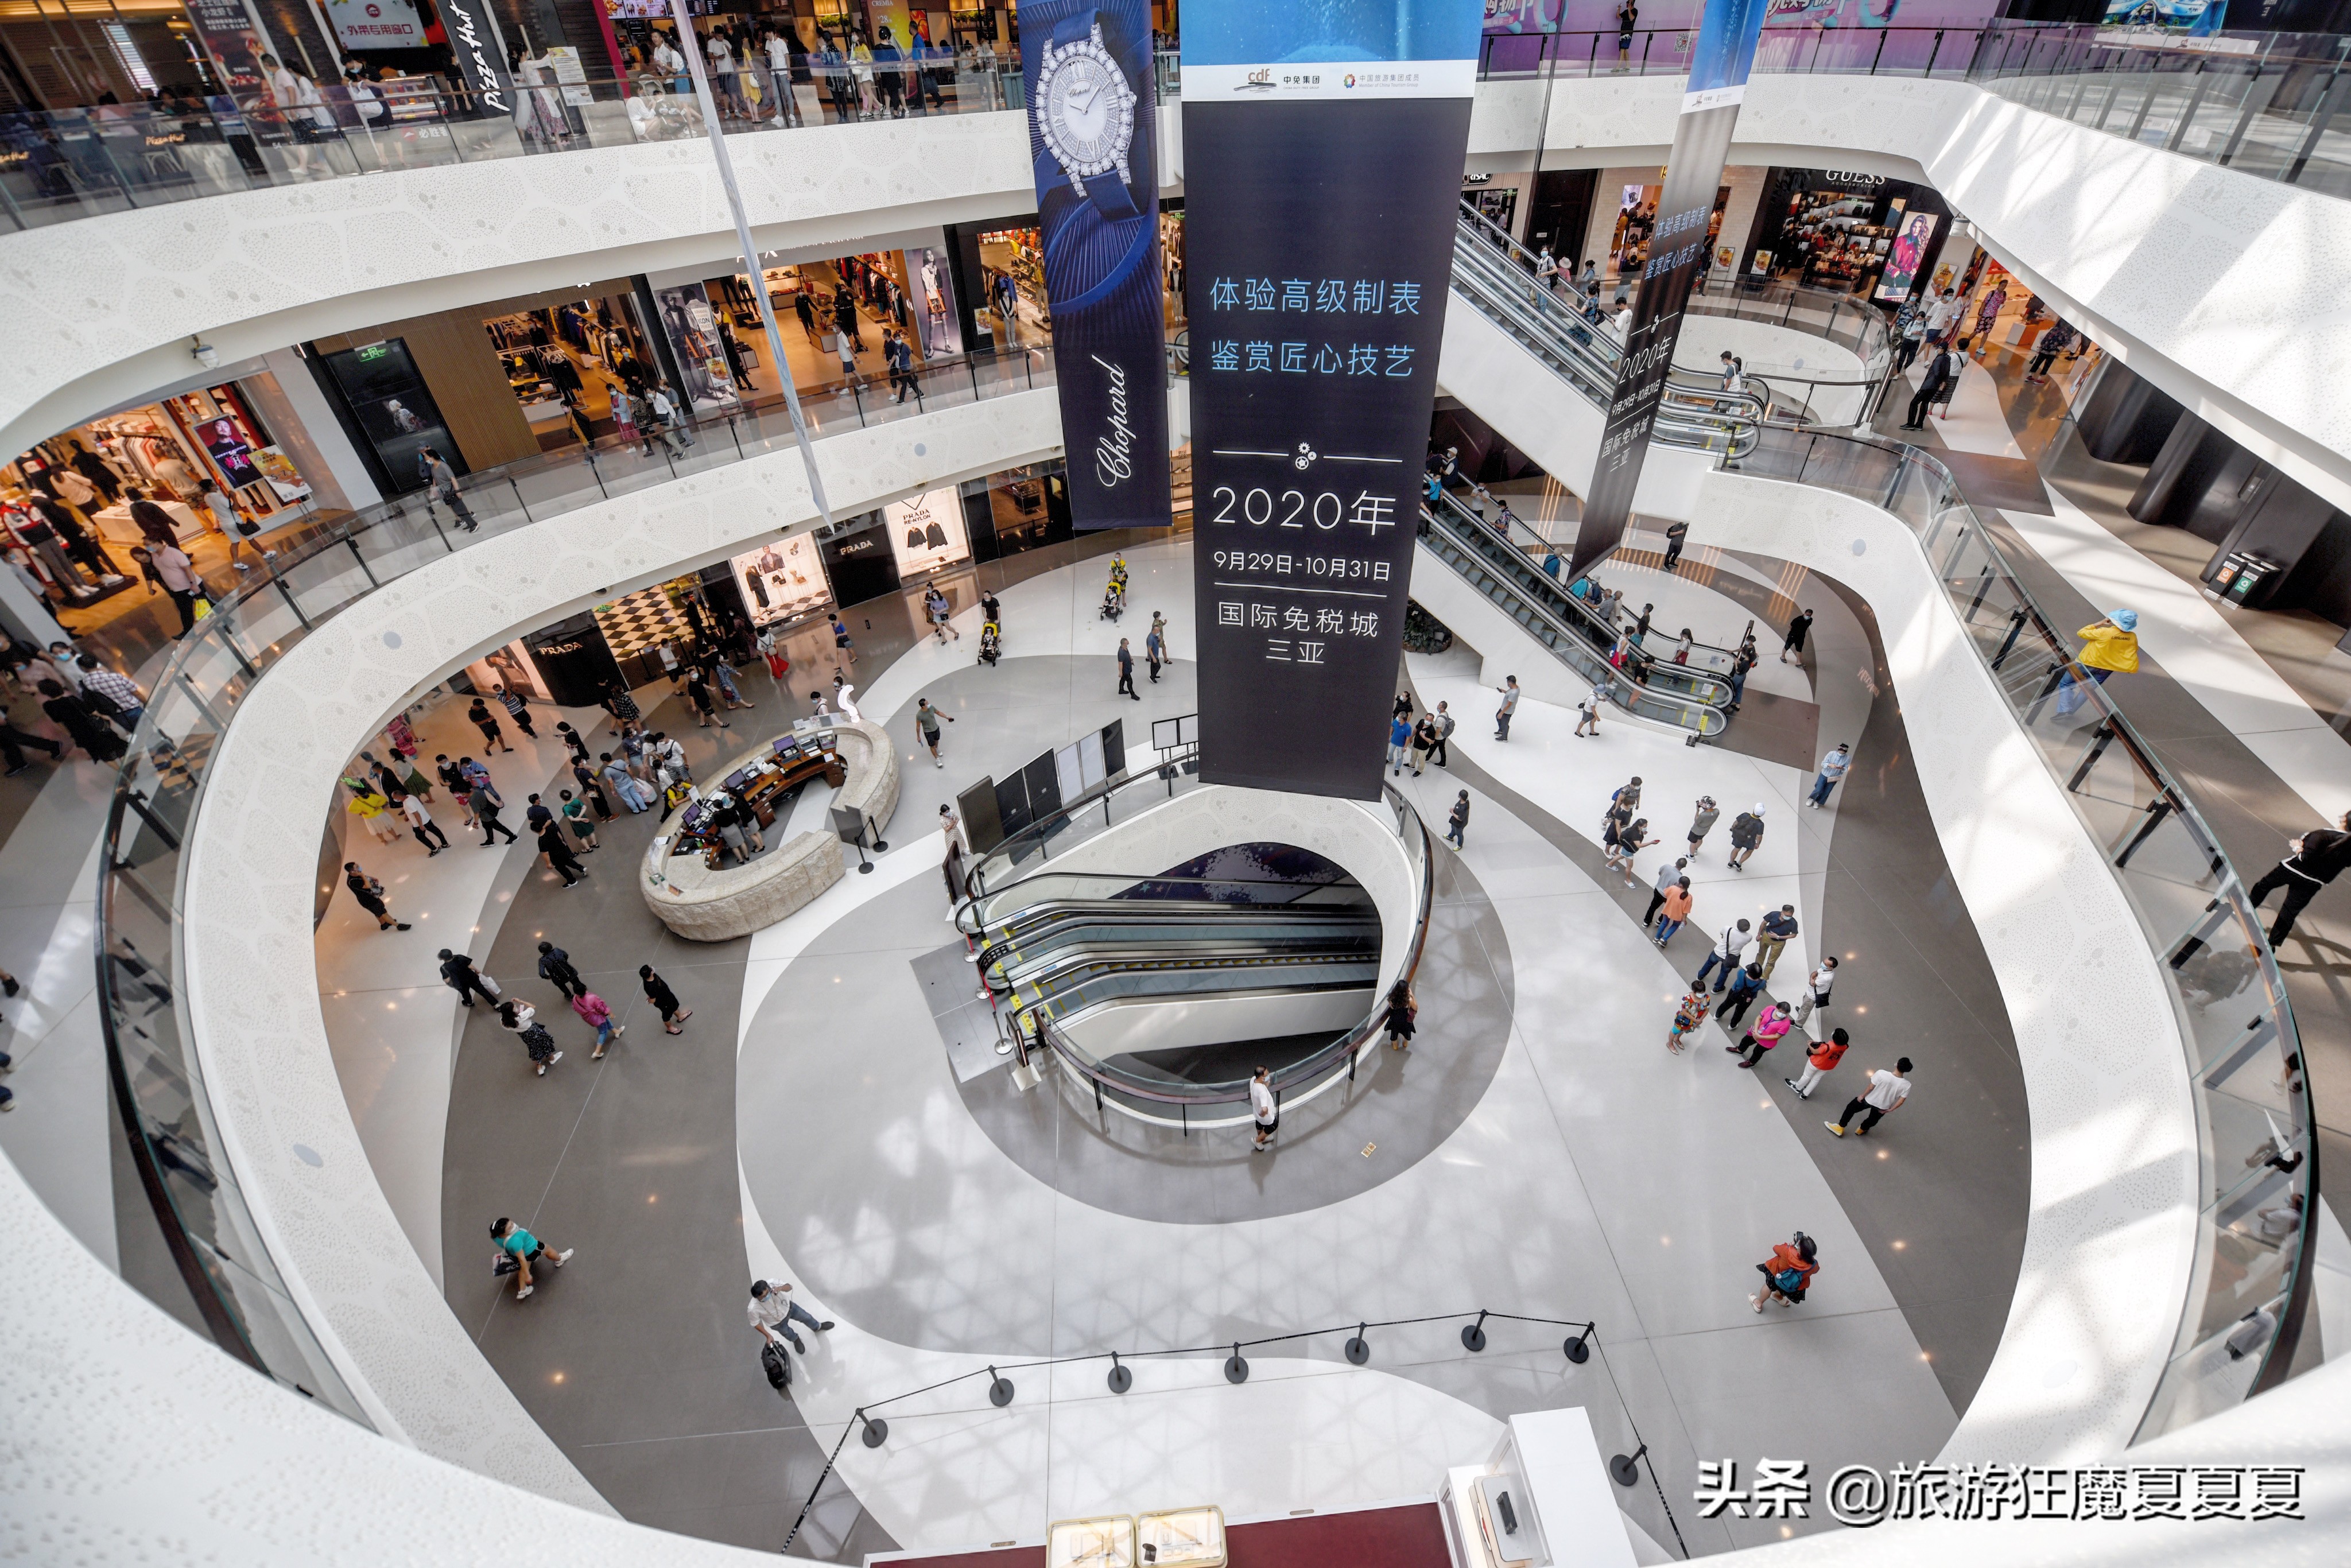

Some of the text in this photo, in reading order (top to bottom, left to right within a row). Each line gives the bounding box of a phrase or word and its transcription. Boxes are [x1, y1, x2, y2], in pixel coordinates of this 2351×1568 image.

[347, 24, 413, 36] 外带专用窗口
[1248, 68, 1270, 82] cdf
[1283, 75, 1320, 84] 中免集团
[1359, 73, 1419, 82] 中国旅游集团成员
[1068, 87, 1091, 98] Chopard
[1826, 170, 1886, 185] GUESS
[1654, 205, 1706, 241] 体验高级制表
[1644, 243, 1697, 280] 鉴赏匠心技艺
[1210, 277, 1421, 315] 体验高级制表
[1211, 340, 1415, 377] 鉴赏匠心技艺
[1619, 336, 1671, 385] 2020年
[1091, 354, 1136, 487] Chopard
[1601, 415, 1650, 459] 国际免税城
[1609, 448, 1631, 472] 三亚
[903, 509, 930, 520] PRADA
[903, 514, 930, 525] RE-NYLON
[1212, 486, 1396, 536] 2020年
[840, 540, 874, 555] PRADA
[1213, 550, 1390, 581] 9月29日-10月31日
[1219, 601, 1379, 638] 国际免税城
[539, 642, 583, 655] PRADA
[1266, 639, 1325, 664] 三亚
